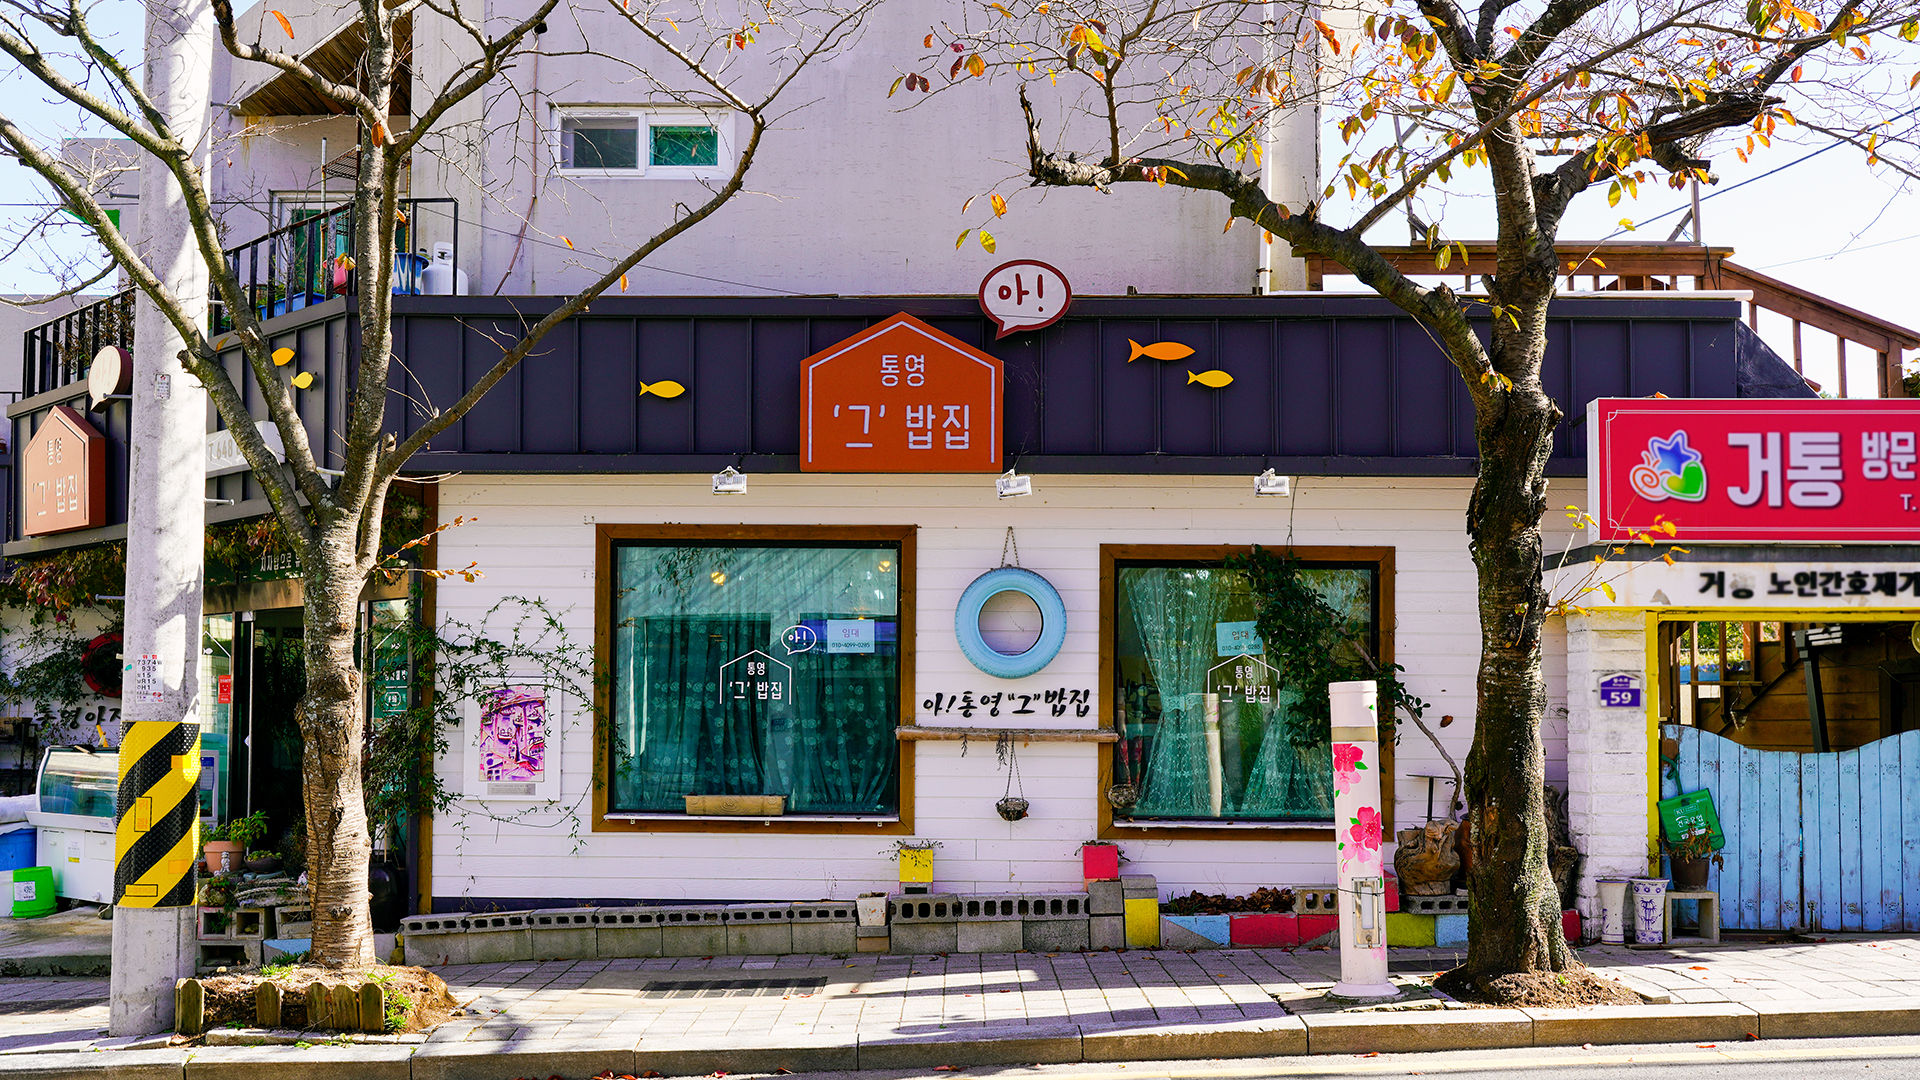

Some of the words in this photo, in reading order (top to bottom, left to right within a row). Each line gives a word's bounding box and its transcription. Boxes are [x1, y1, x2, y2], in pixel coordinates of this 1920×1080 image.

[998, 272, 1044, 313] 아!
[880, 353, 925, 387] 통영
[833, 404, 886, 448] '그'
[905, 404, 970, 450] 밥집
[46, 437, 62, 466] 통영
[216, 438, 233, 460] 648
[1726, 431, 1843, 507] 거통
[1861, 431, 1917, 480] 방문
[54, 473, 78, 514] 밥집
[1899, 493, 1917, 512] T.
[787, 629, 807, 646] 아!
[841, 628, 860, 638] 임대
[1231, 630, 1249, 640] 임대
[747, 661, 766, 676] 통영
[1235, 665, 1253, 679] 통영
[729, 681, 751, 699] '그'
[756, 681, 783, 700] 밥집
[1216, 684, 1239, 703] '그'
[1244, 685, 1271, 704] 밥집
[1610, 691, 1632, 704] 59
